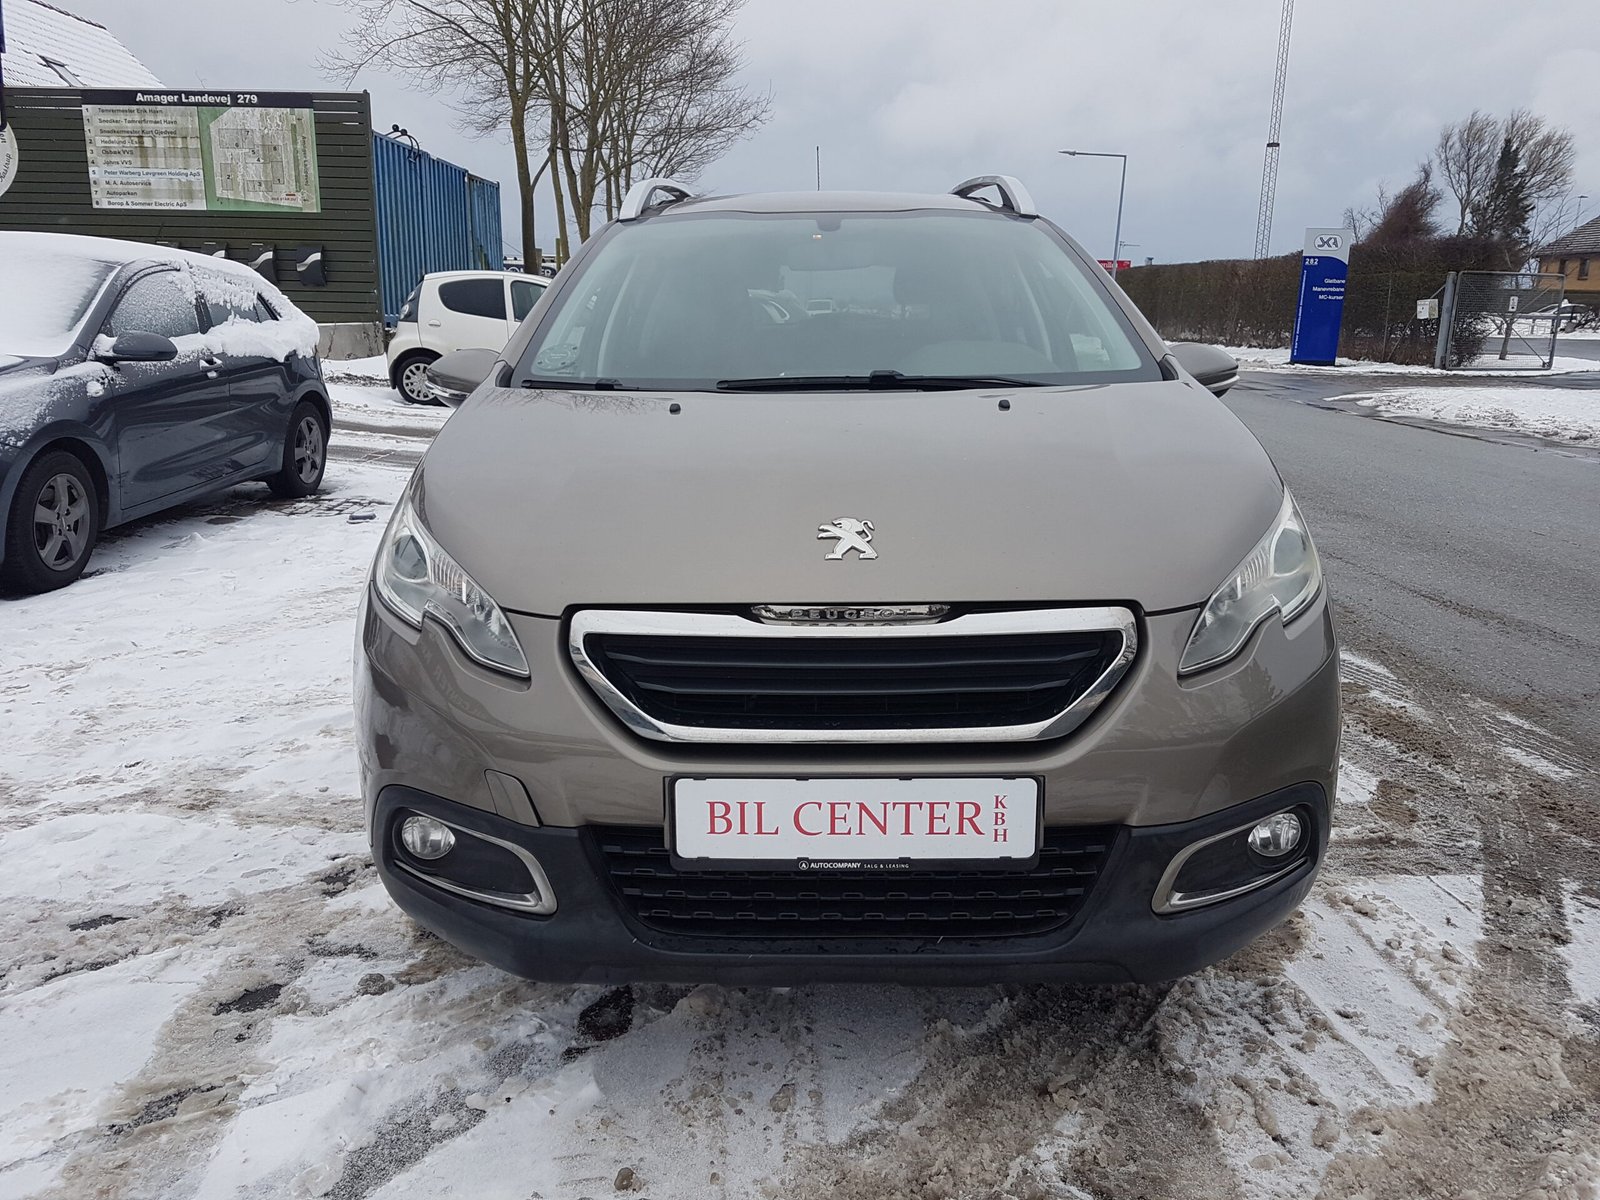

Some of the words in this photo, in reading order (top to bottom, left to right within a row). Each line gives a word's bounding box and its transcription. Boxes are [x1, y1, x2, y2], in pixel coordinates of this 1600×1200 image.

[136, 93, 178, 104] Amager
[182, 94, 230, 104] Landevej
[237, 95, 257, 103] 279
[790, 608, 911, 619] PEUGEOT
[706, 801, 779, 835] BIL
[792, 801, 985, 836] CENTER
[992, 794, 1008, 843] KBH
